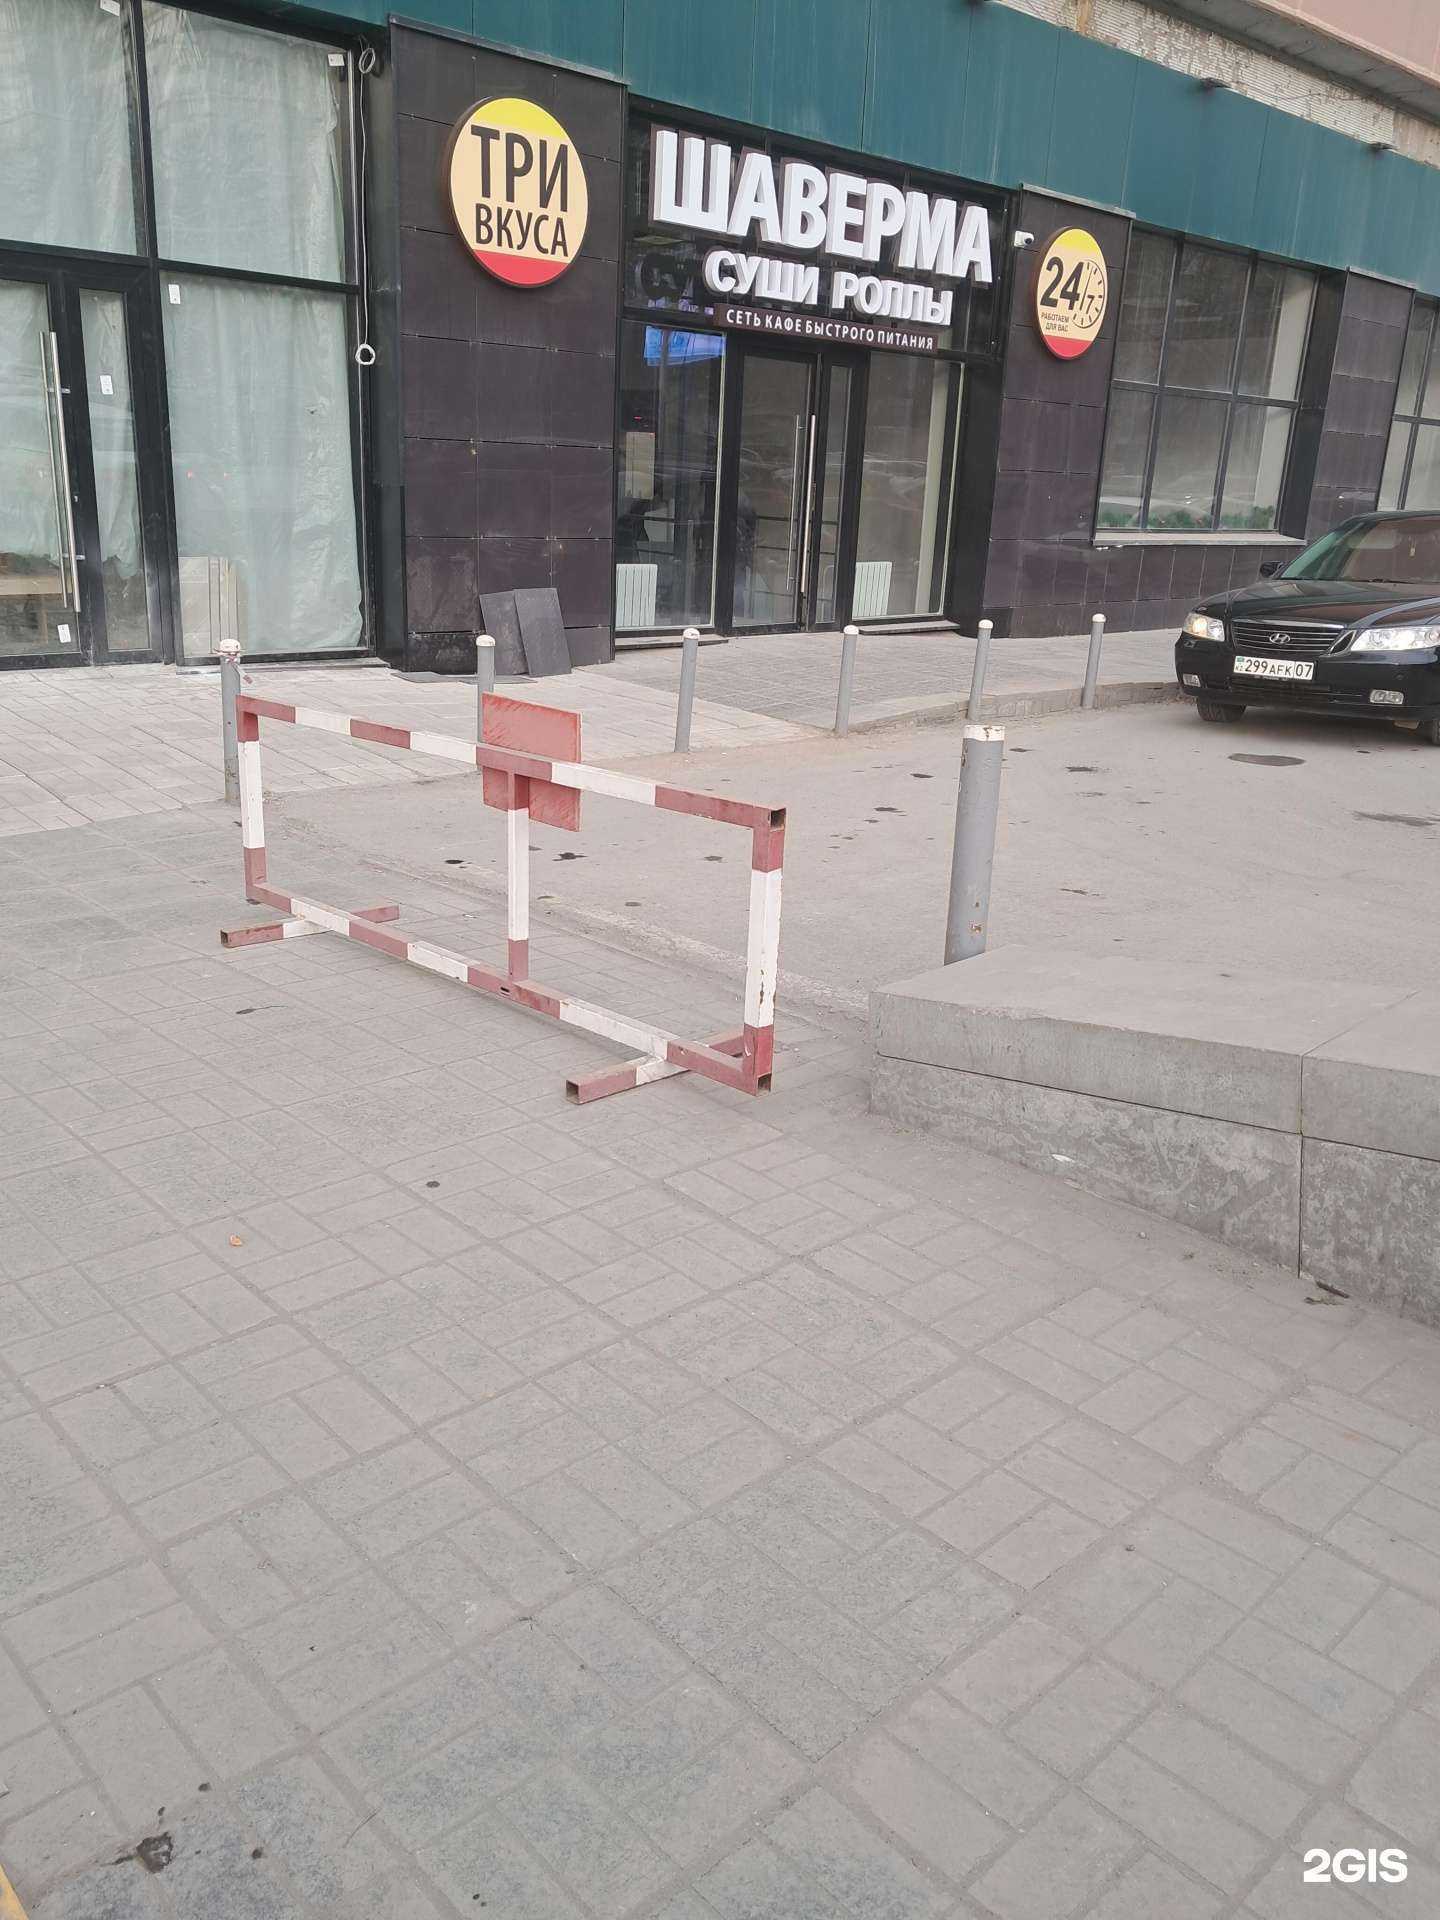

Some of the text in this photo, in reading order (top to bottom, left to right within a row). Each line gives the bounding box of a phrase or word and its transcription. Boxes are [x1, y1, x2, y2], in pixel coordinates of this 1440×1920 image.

[470, 124, 569, 213] ТРИ
[475, 202, 569, 258] ВКУСА
[652, 129, 993, 284] ШАВЕРМА
[704, 250, 953, 325] СУШИ РОЛЛЫ
[726, 309, 934, 350] СЕТЬ КАФЕ БЫСТРОГО ПИТАНИЯ
